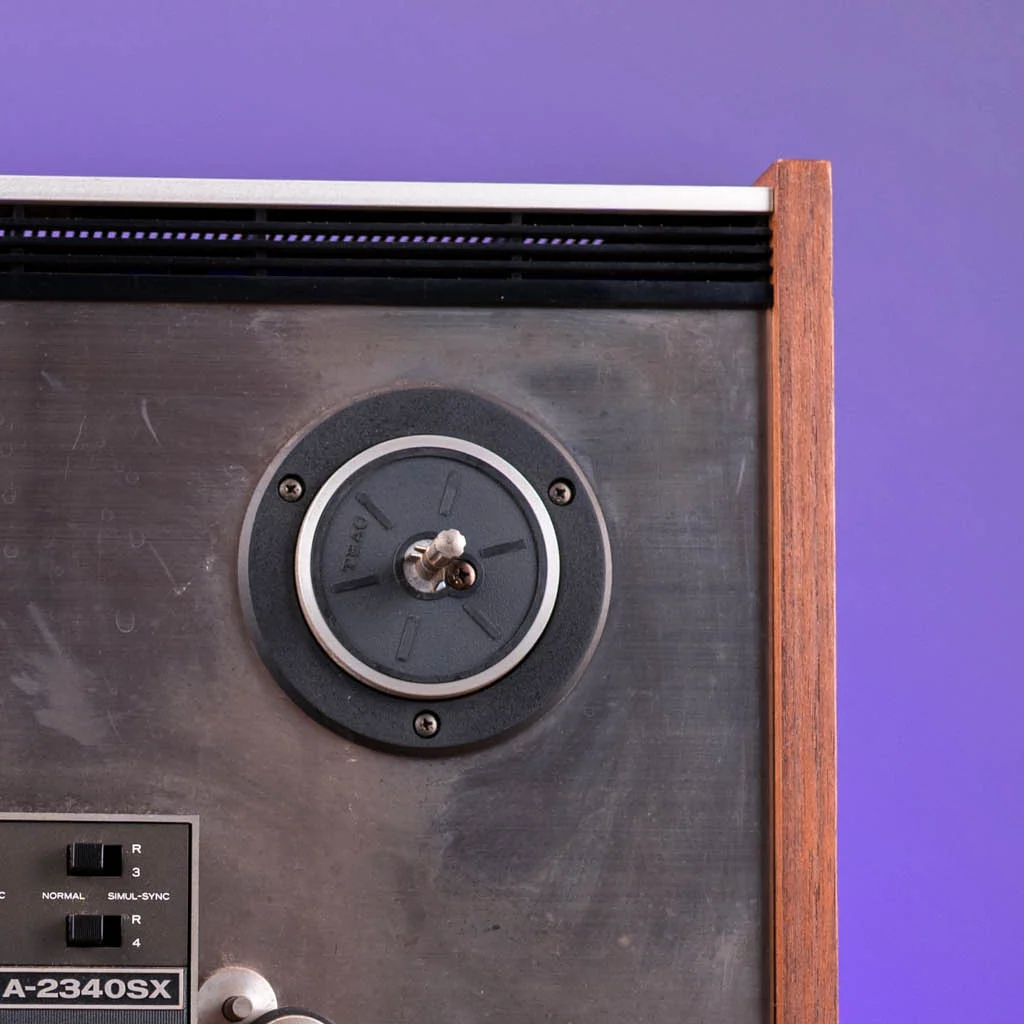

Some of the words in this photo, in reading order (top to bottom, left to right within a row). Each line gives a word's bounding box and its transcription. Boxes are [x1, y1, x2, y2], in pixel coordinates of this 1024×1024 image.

[131, 844, 142, 853] R
[131, 867, 141, 877] 3
[41, 892, 86, 900] NORMAL
[107, 892, 170, 900] SIMUL-SYNC
[131, 915, 142, 924] R
[131, 938, 141, 947] 4
[2, 979, 172, 999] A-2340SX
